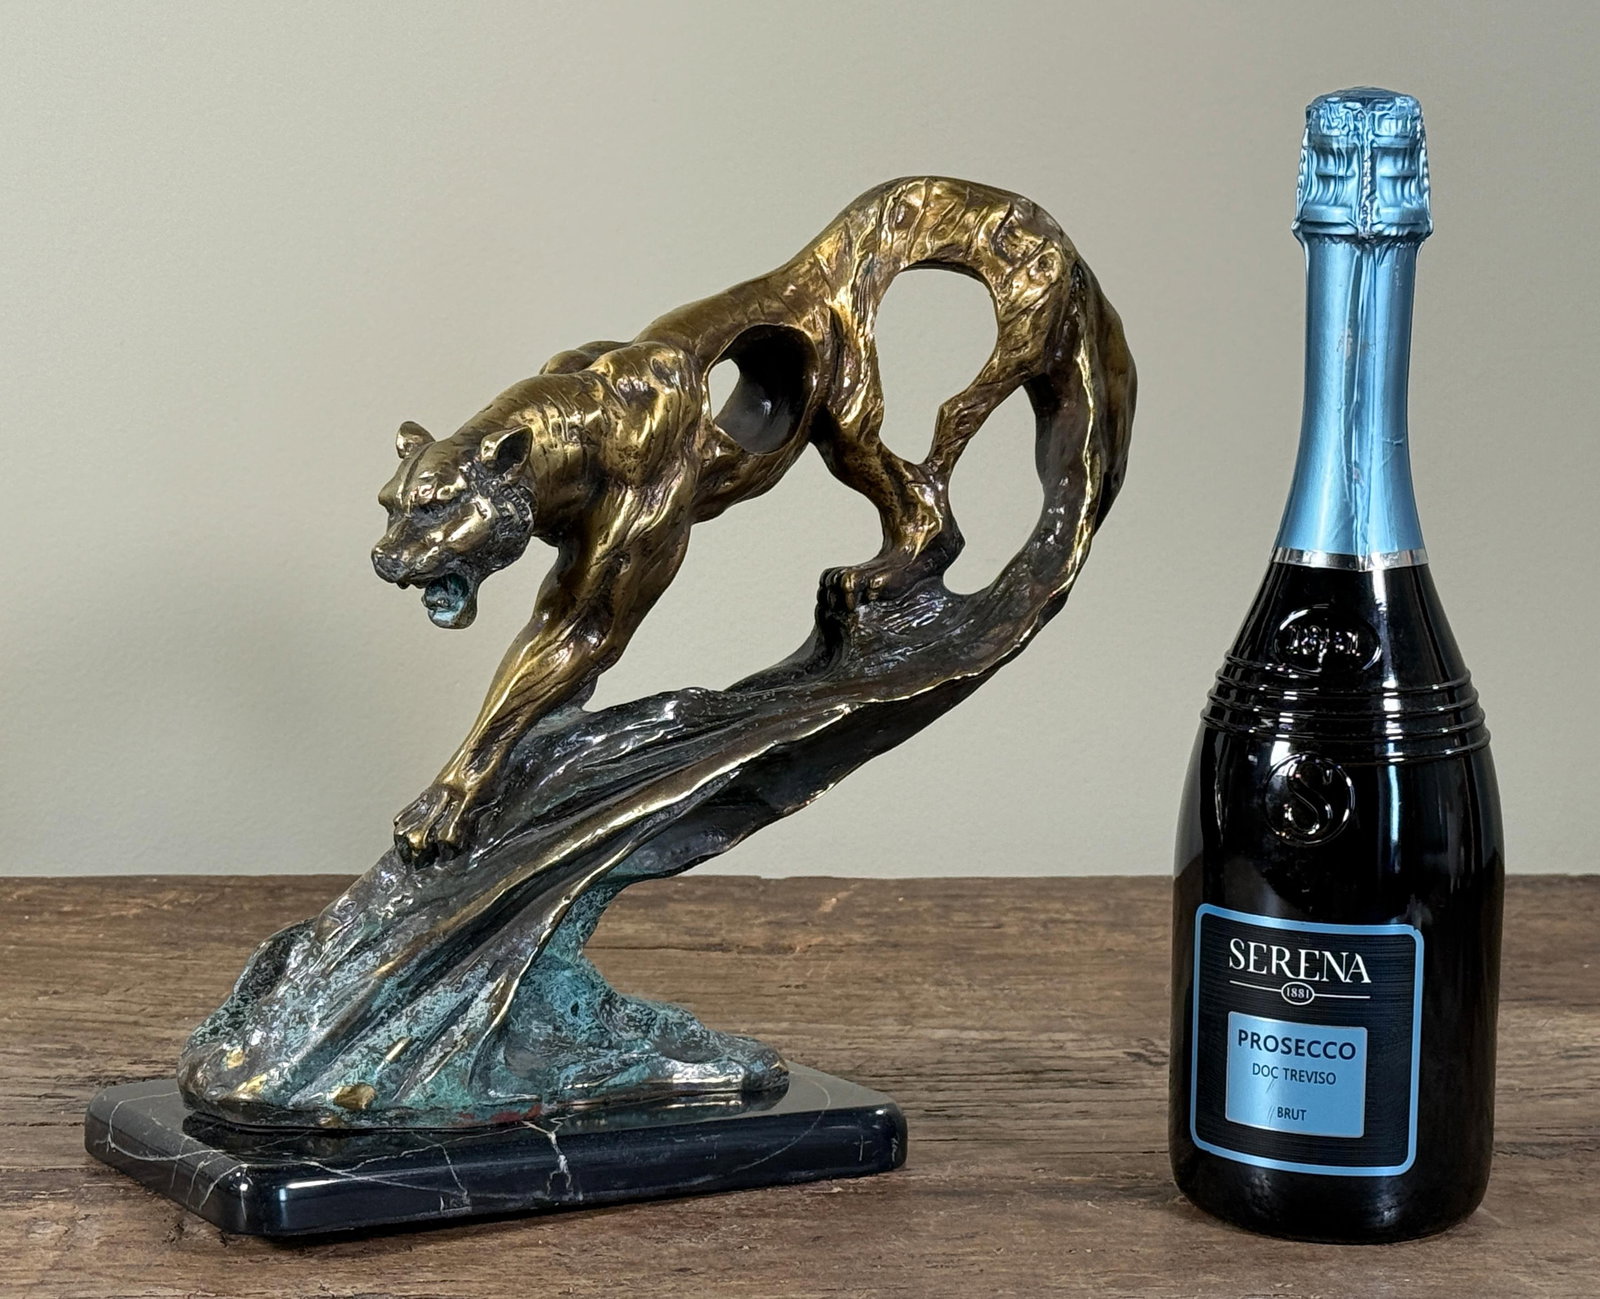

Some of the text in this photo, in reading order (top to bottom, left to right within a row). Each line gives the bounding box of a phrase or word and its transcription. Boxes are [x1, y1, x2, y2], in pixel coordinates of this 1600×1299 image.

[1228, 938, 1372, 984] SERENA
[1285, 986, 1310, 999] 1881
[1237, 1029, 1357, 1060] PROSECCO
[1252, 1063, 1337, 1085] DOC TREVISO
[1276, 1106, 1307, 1121] BRUT
